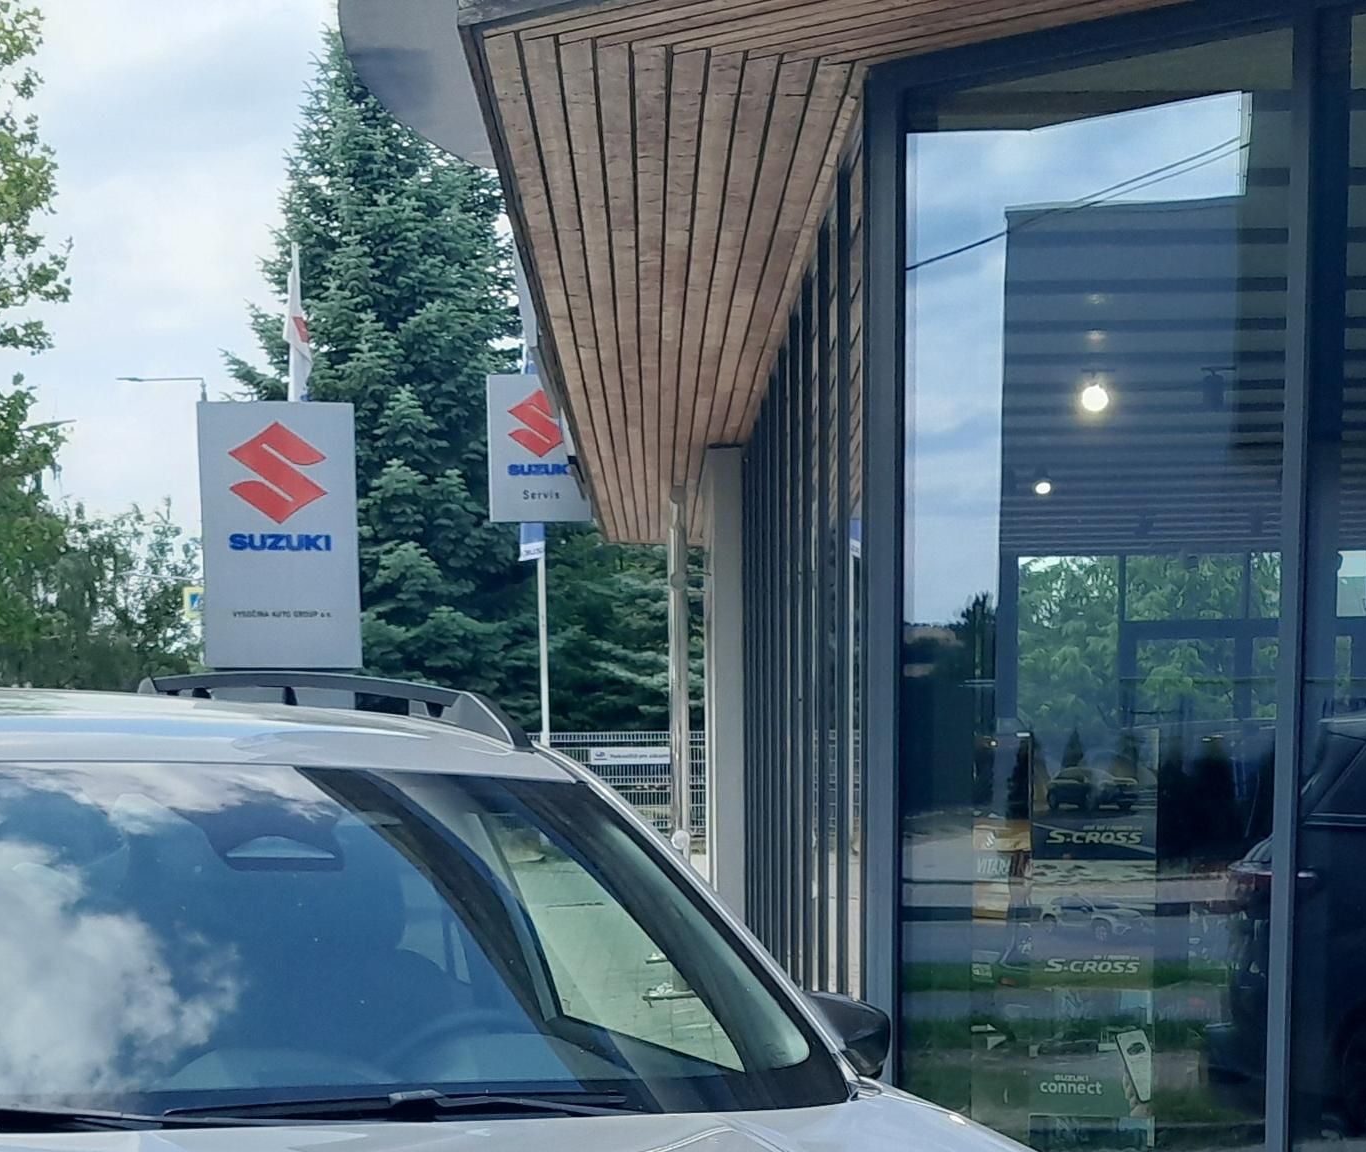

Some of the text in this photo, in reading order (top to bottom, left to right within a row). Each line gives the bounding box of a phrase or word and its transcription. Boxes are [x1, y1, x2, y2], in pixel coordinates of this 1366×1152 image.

[508, 463, 570, 476] SUZUK
[523, 489, 560, 500] Servis
[228, 533, 332, 551] SUZUKI
[272, 610, 291, 618] AUTO
[293, 610, 319, 618] GROUP
[1046, 829, 1144, 844] S-CROSS
[1044, 958, 1141, 973] S-CROSS
[1039, 1081, 1103, 1095] connect
